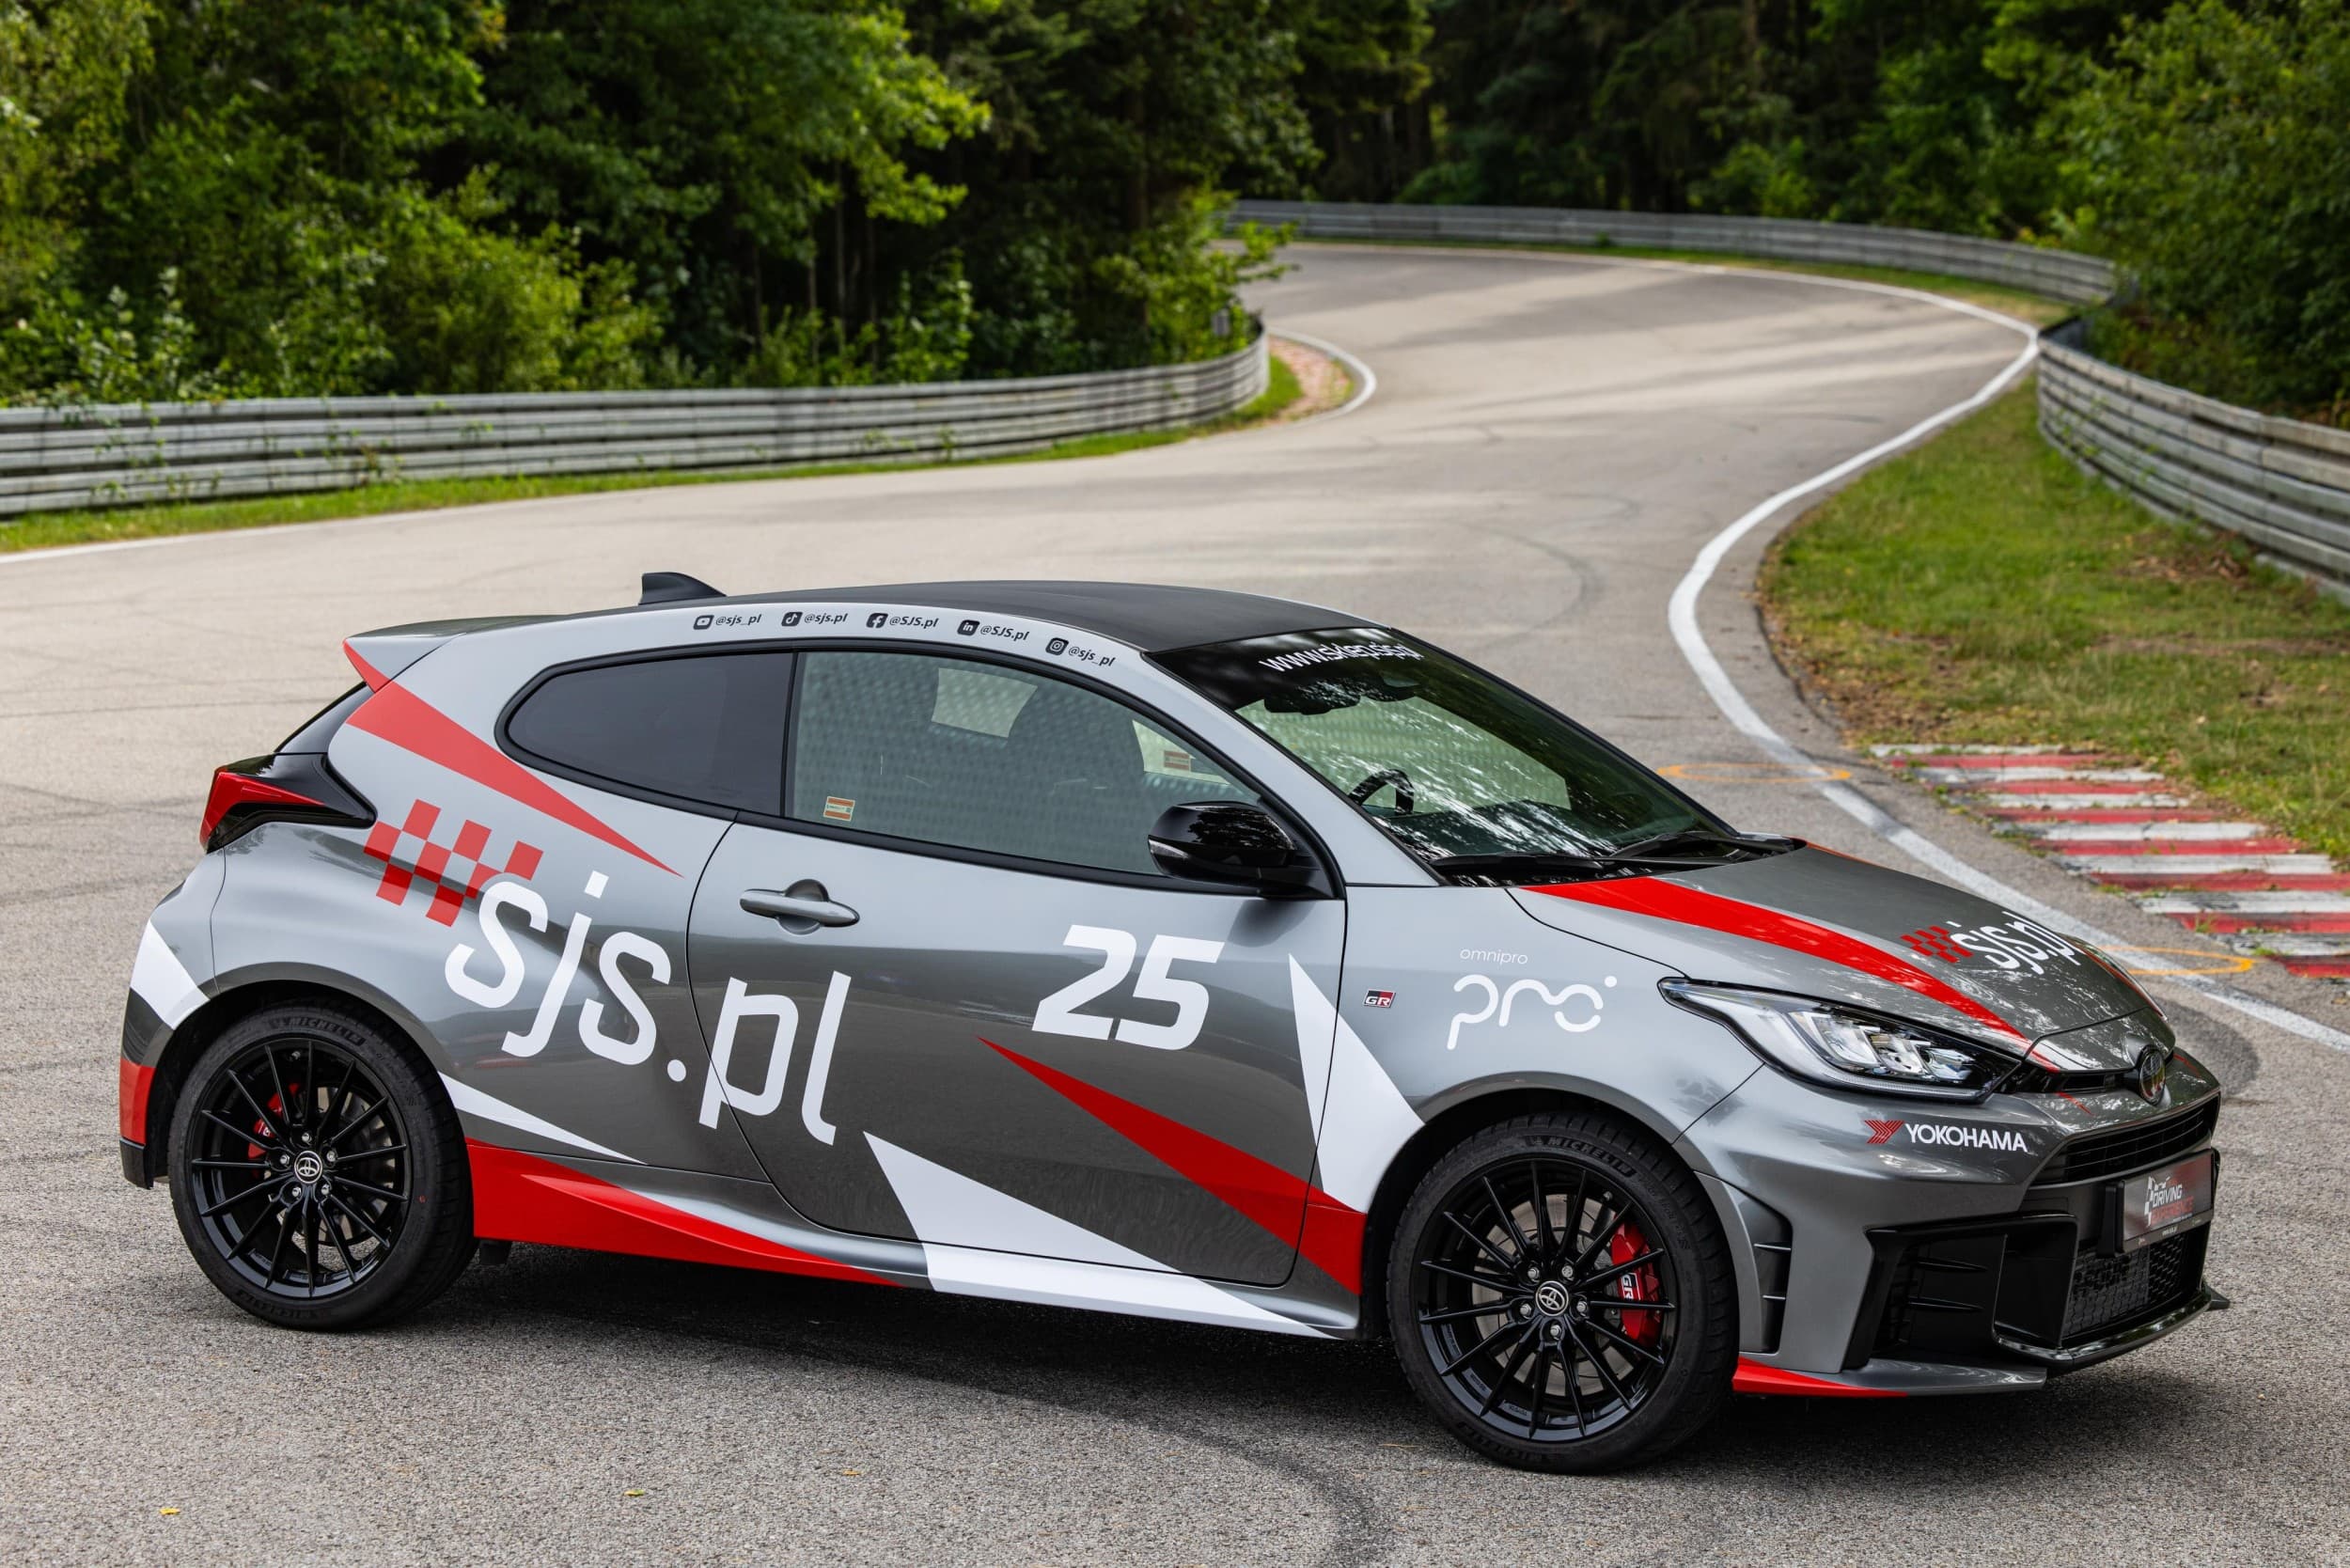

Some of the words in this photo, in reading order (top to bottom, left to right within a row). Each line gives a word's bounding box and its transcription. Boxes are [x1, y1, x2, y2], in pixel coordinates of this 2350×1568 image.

[715, 614, 762, 626] @sjs_pl
[804, 612, 849, 624] @sjs.pl
[889, 615, 939, 629] @SJS.pl
[980, 624, 1030, 641] @SJS.pl
[1068, 645, 1117, 666] @sjs_pl
[1945, 911, 2087, 975] sjs.pl
[1459, 948, 1528, 965] omnipro
[1031, 924, 1226, 1051] 25
[445, 870, 852, 1146] sjs.pl
[1364, 995, 1392, 1007] GR
[290, 1017, 362, 1043] MICHELIN
[1904, 1123, 2029, 1152] YOKOHAMA
[1547, 1137, 1632, 1174] MICHELIN
[2153, 1184, 2183, 1208] DRIVING
